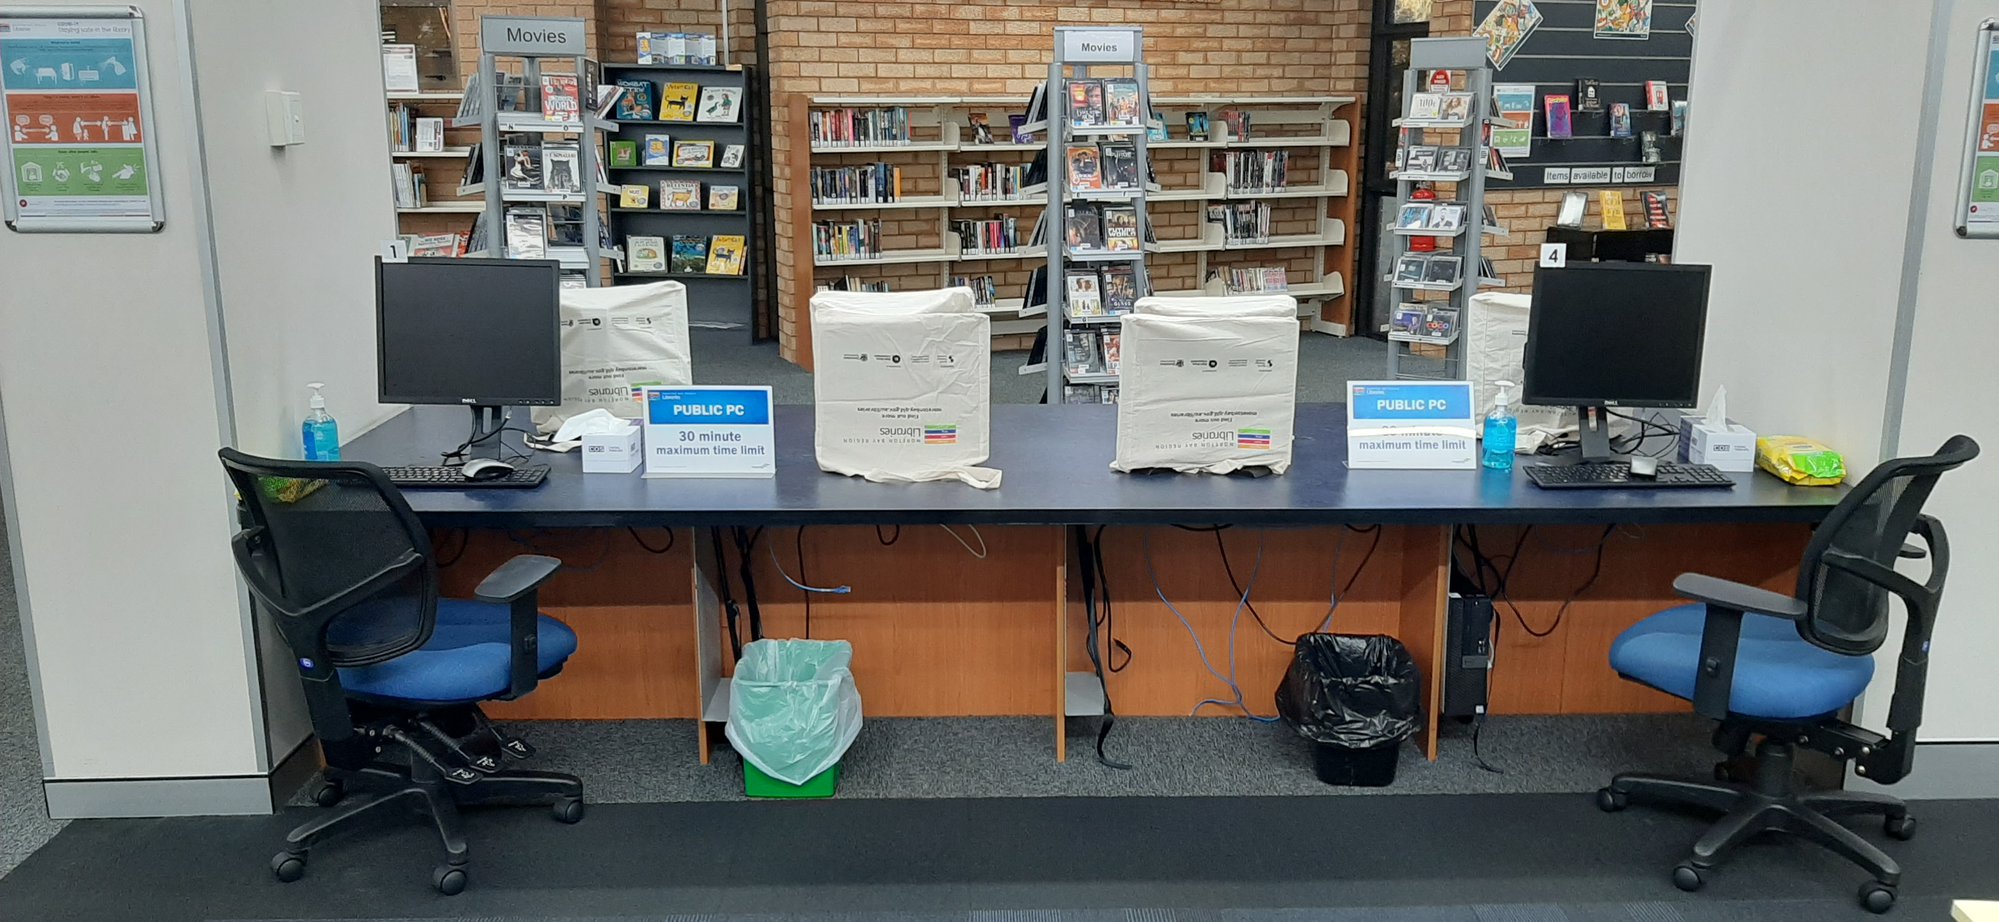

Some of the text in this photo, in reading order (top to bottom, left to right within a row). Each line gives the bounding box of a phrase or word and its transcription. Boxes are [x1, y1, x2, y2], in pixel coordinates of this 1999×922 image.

[506, 27, 567, 43] Movies
[1081, 42, 1118, 53] Movies
[1546, 169, 1652, 180] Items available to borrow
[390, 245, 398, 258] 1
[1548, 249, 1558, 263] 4
[588, 387, 628, 396] Libraries
[673, 404, 745, 416] PUBLIC PC
[1377, 400, 1447, 410] PUBLIC PC
[679, 430, 741, 441] 30 minute
[880, 427, 921, 436] Libraries
[1192, 431, 1234, 441] Libraries
[656, 445, 765, 455] maximum time limit
[1359, 440, 1466, 449] maximum time limit
